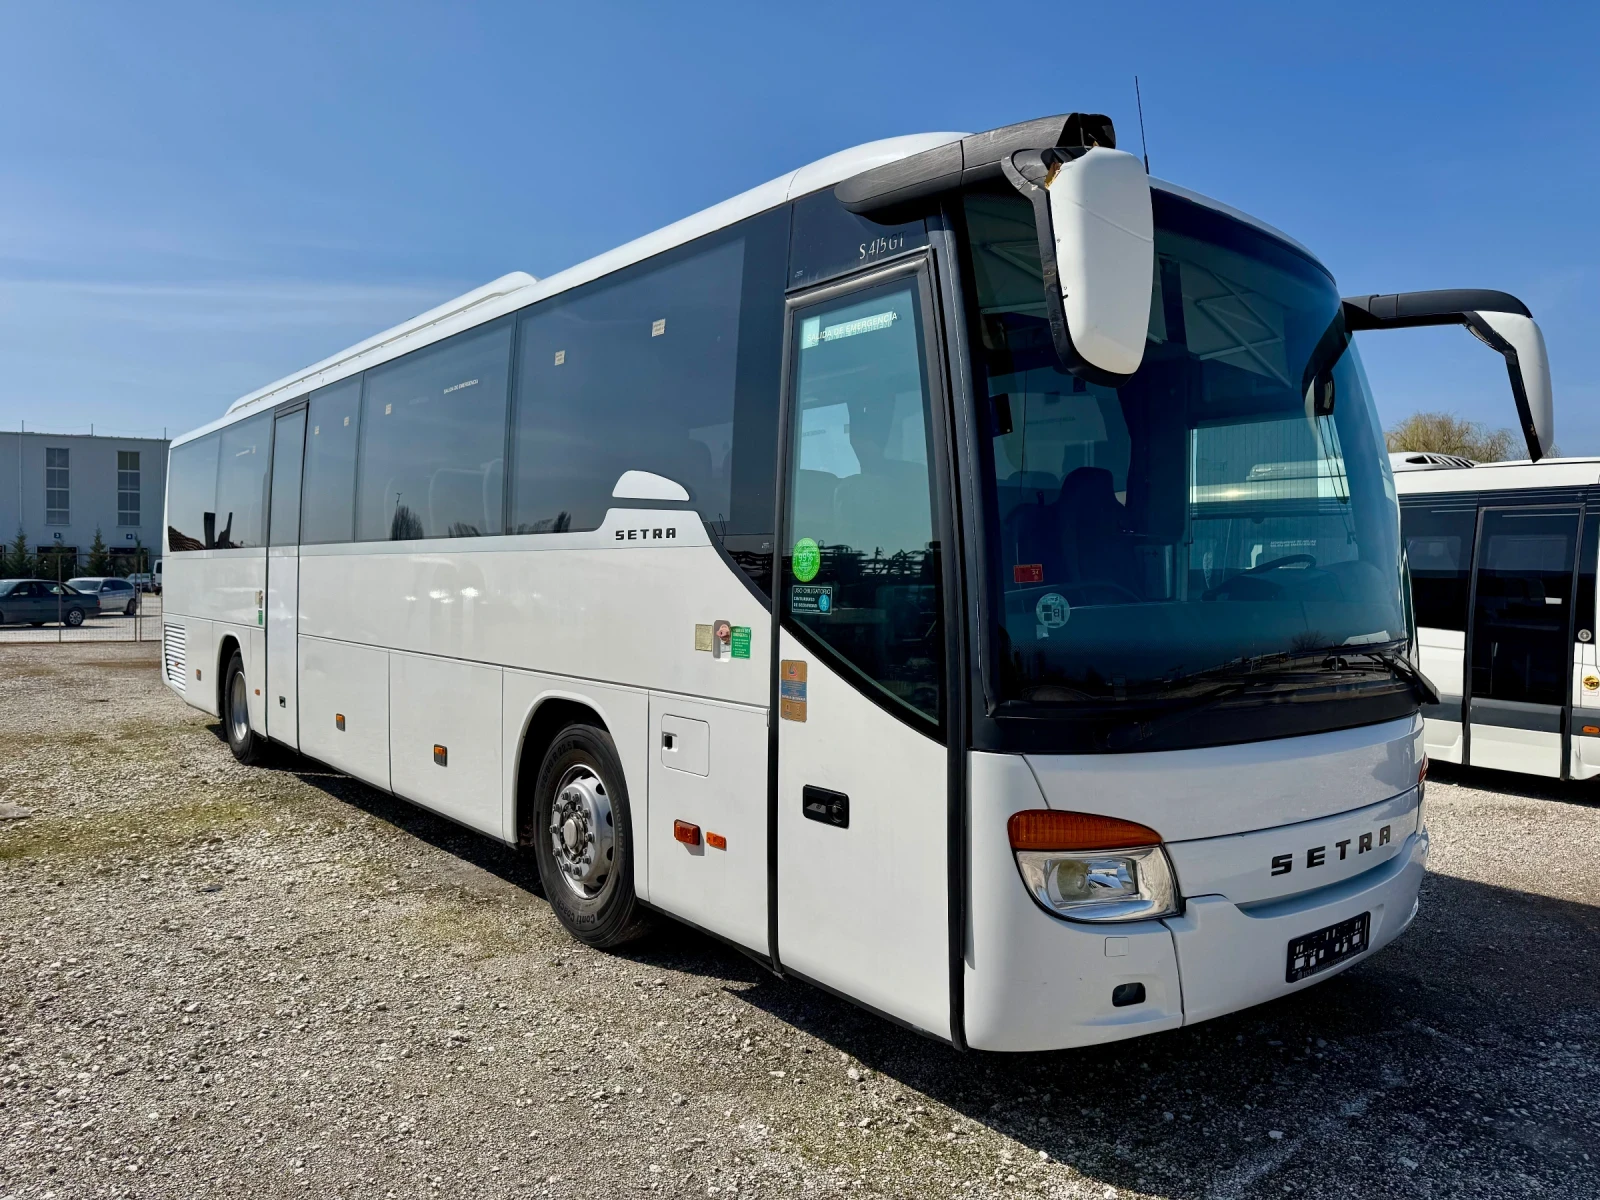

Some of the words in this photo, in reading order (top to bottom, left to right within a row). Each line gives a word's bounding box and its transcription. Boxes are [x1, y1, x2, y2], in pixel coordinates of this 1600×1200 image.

[859, 243, 866, 260] S
[868, 237, 887, 256] 415
[888, 232, 906, 250] GT
[806, 330, 832, 342] SALIDA
[833, 326, 845, 336] DE
[845, 311, 898, 333] EMERGENCIA
[615, 528, 676, 541] SETRA
[1271, 825, 1391, 877] SETRA
[556, 898, 575, 923] Coach
[576, 913, 596, 925] Conti
